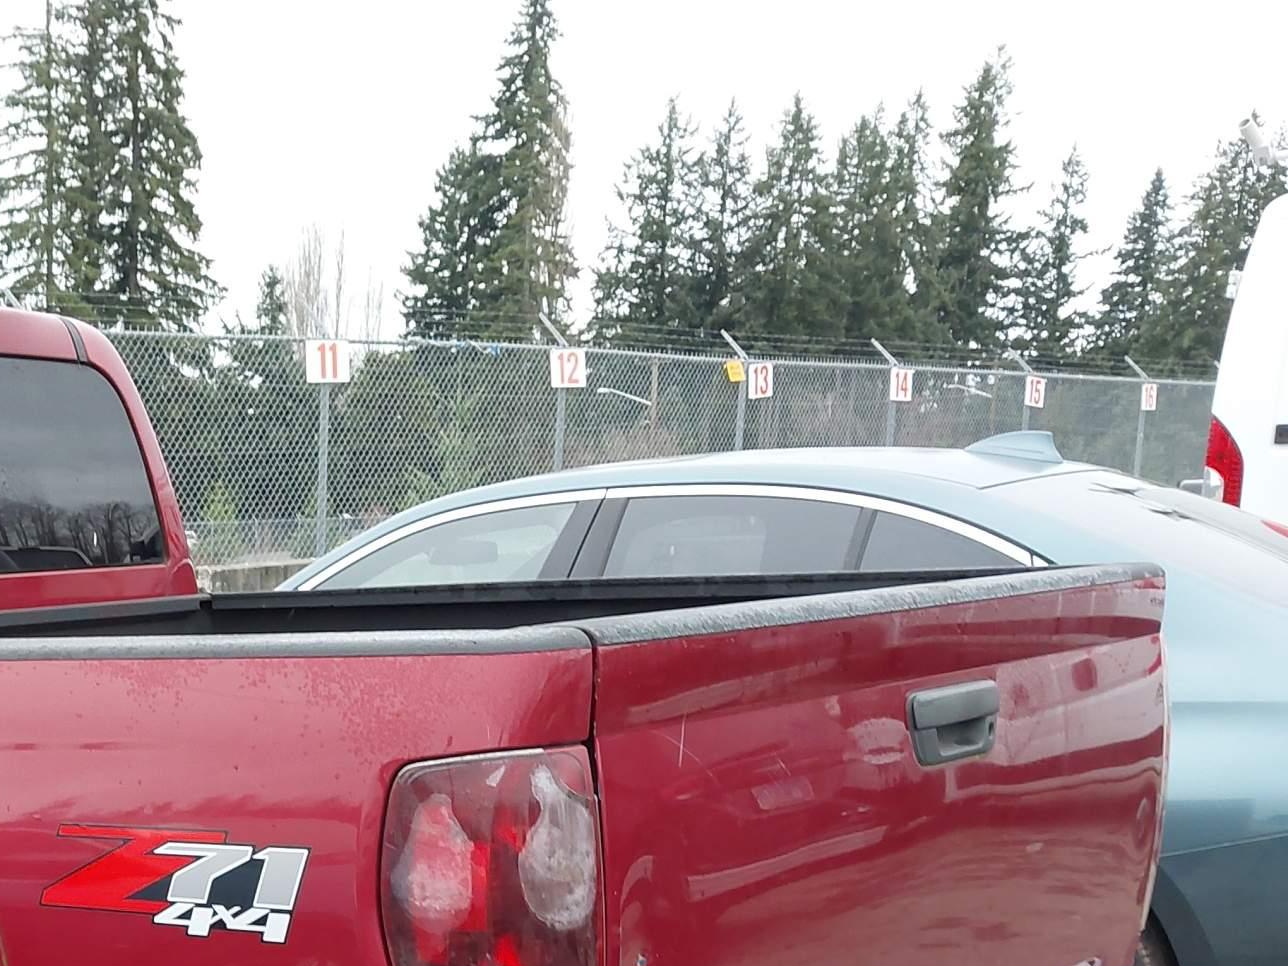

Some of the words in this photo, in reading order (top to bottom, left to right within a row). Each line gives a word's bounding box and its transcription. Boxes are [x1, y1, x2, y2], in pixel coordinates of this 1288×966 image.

[317, 342, 339, 379] 11
[557, 351, 580, 384] 12
[753, 365, 769, 396] 13
[895, 371, 909, 398] 14
[1028, 379, 1042, 405] 15
[41, 824, 310, 913] Z71
